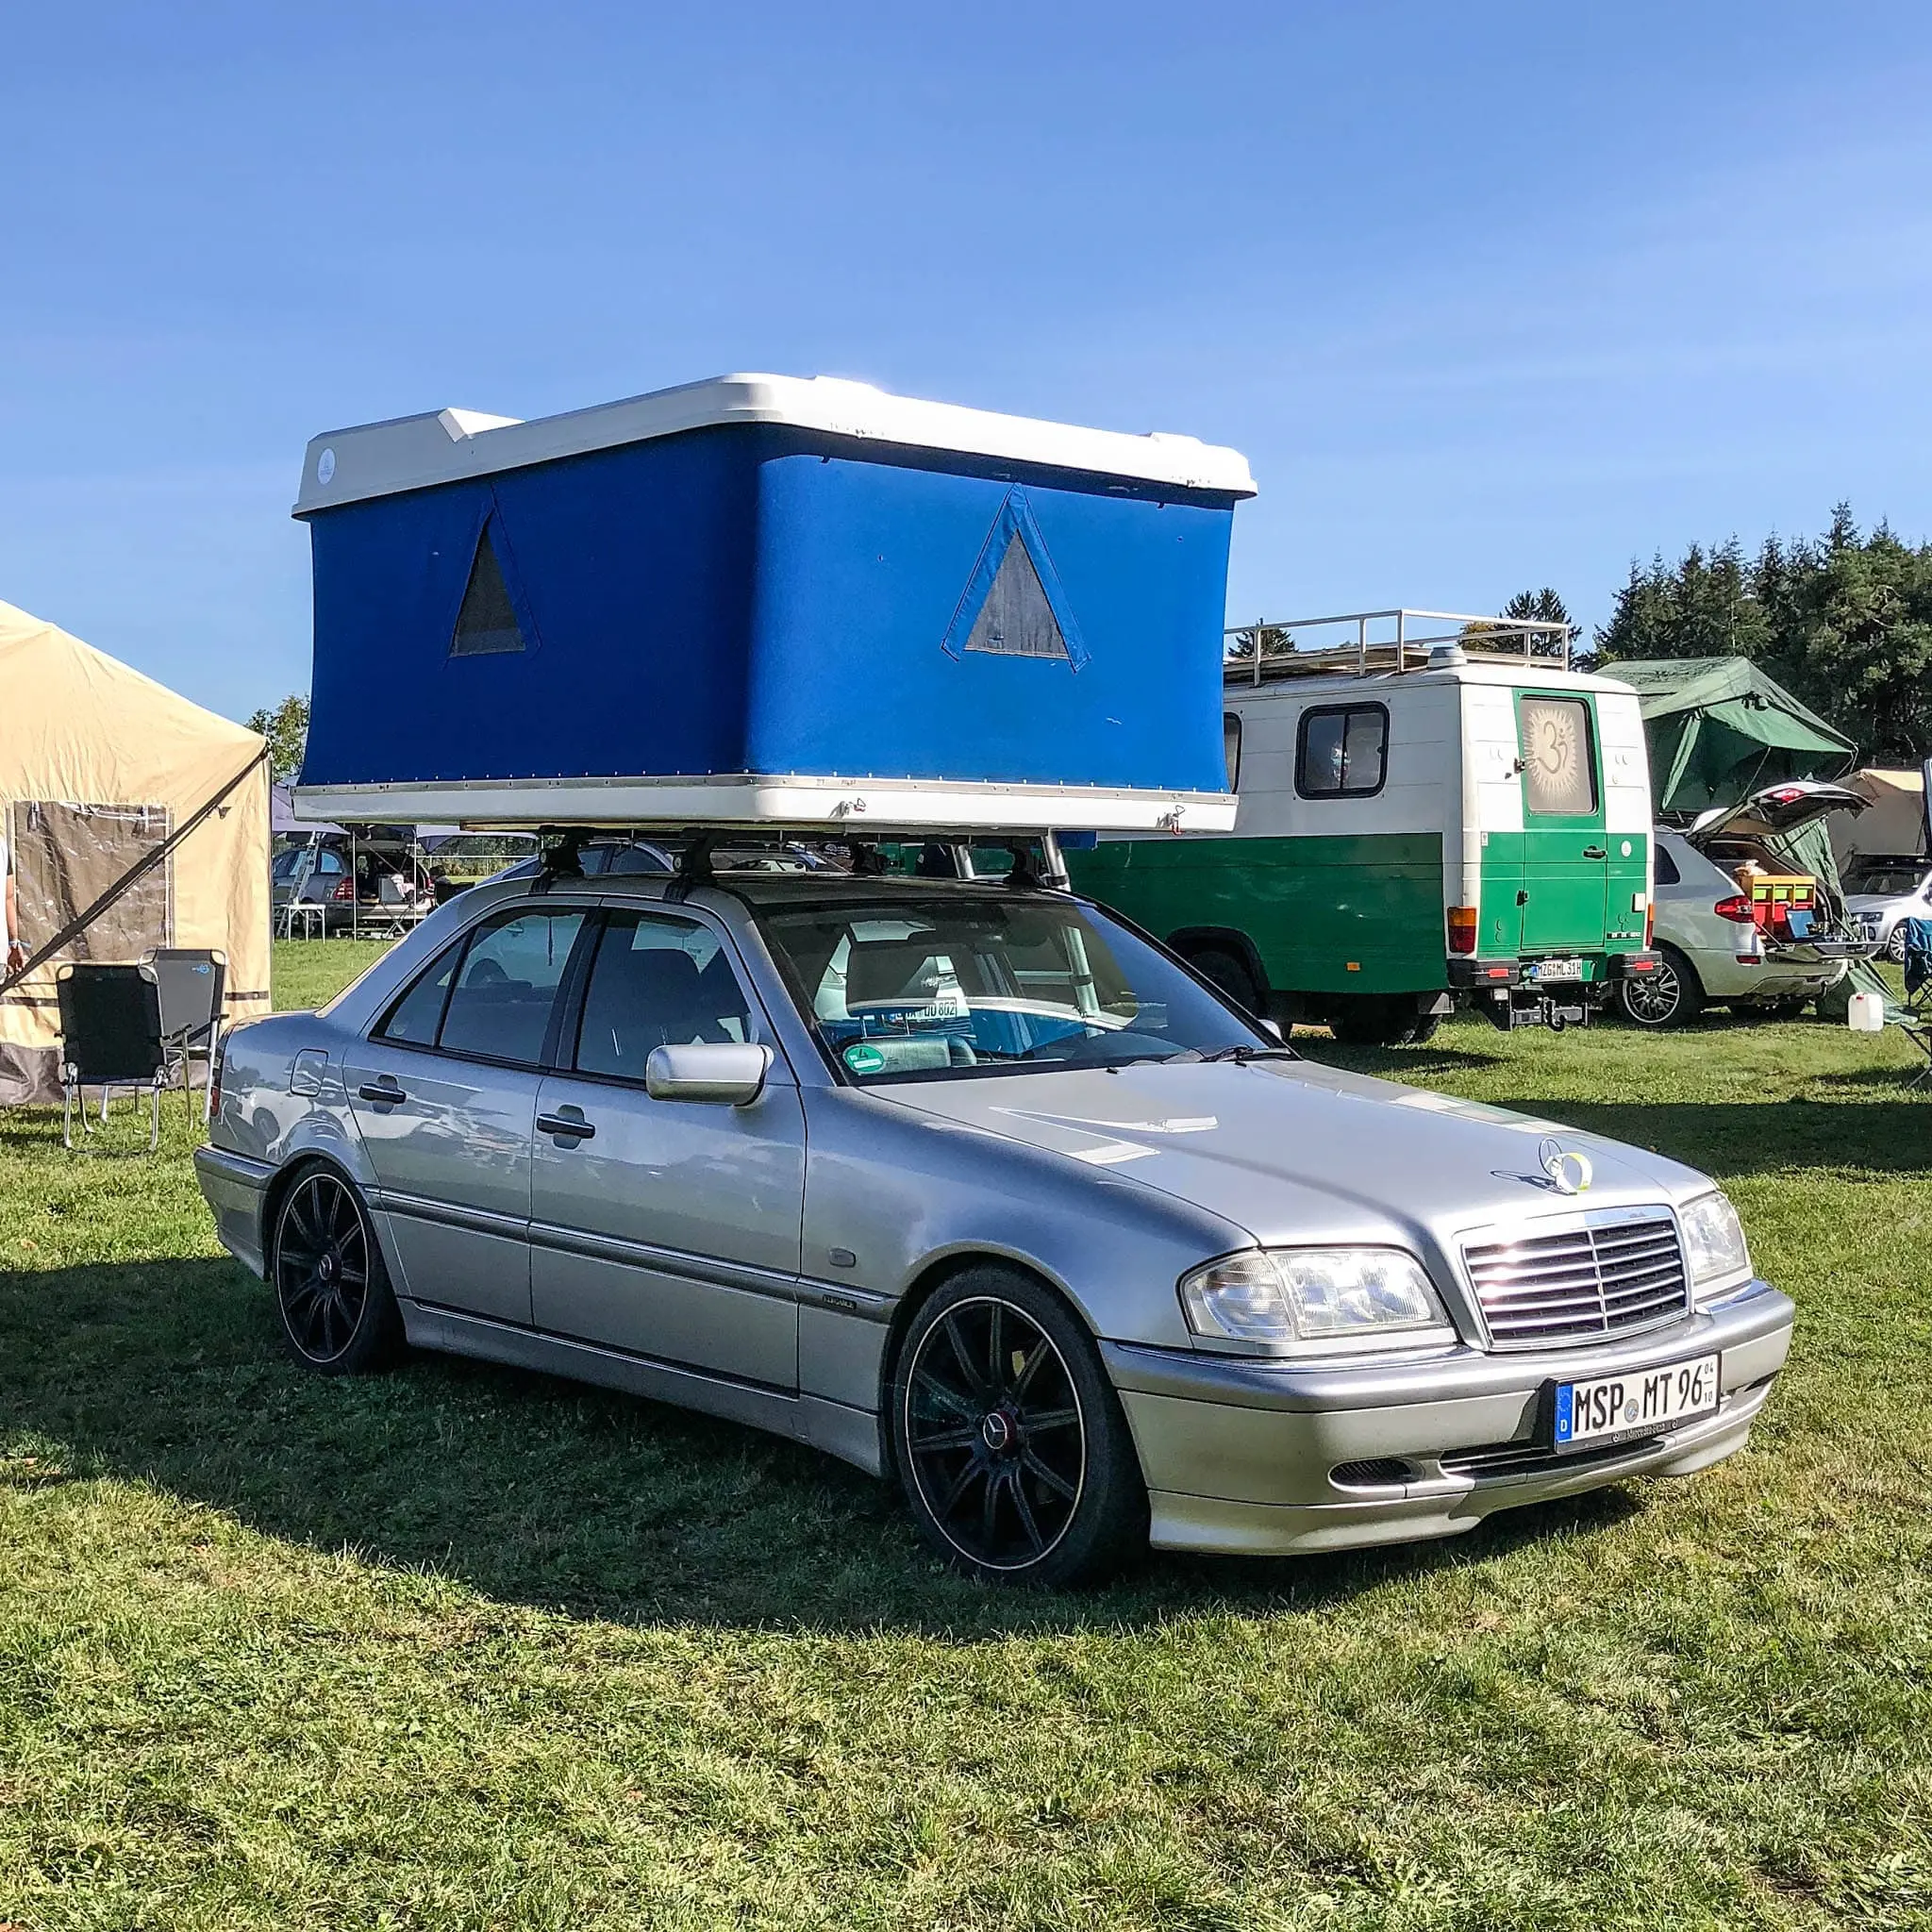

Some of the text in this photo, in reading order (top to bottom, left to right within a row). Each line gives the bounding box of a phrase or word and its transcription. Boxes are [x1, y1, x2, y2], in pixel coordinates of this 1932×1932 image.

[1574, 1364, 1703, 1432] MSP MT 96
[1559, 1419, 1567, 1432] D
